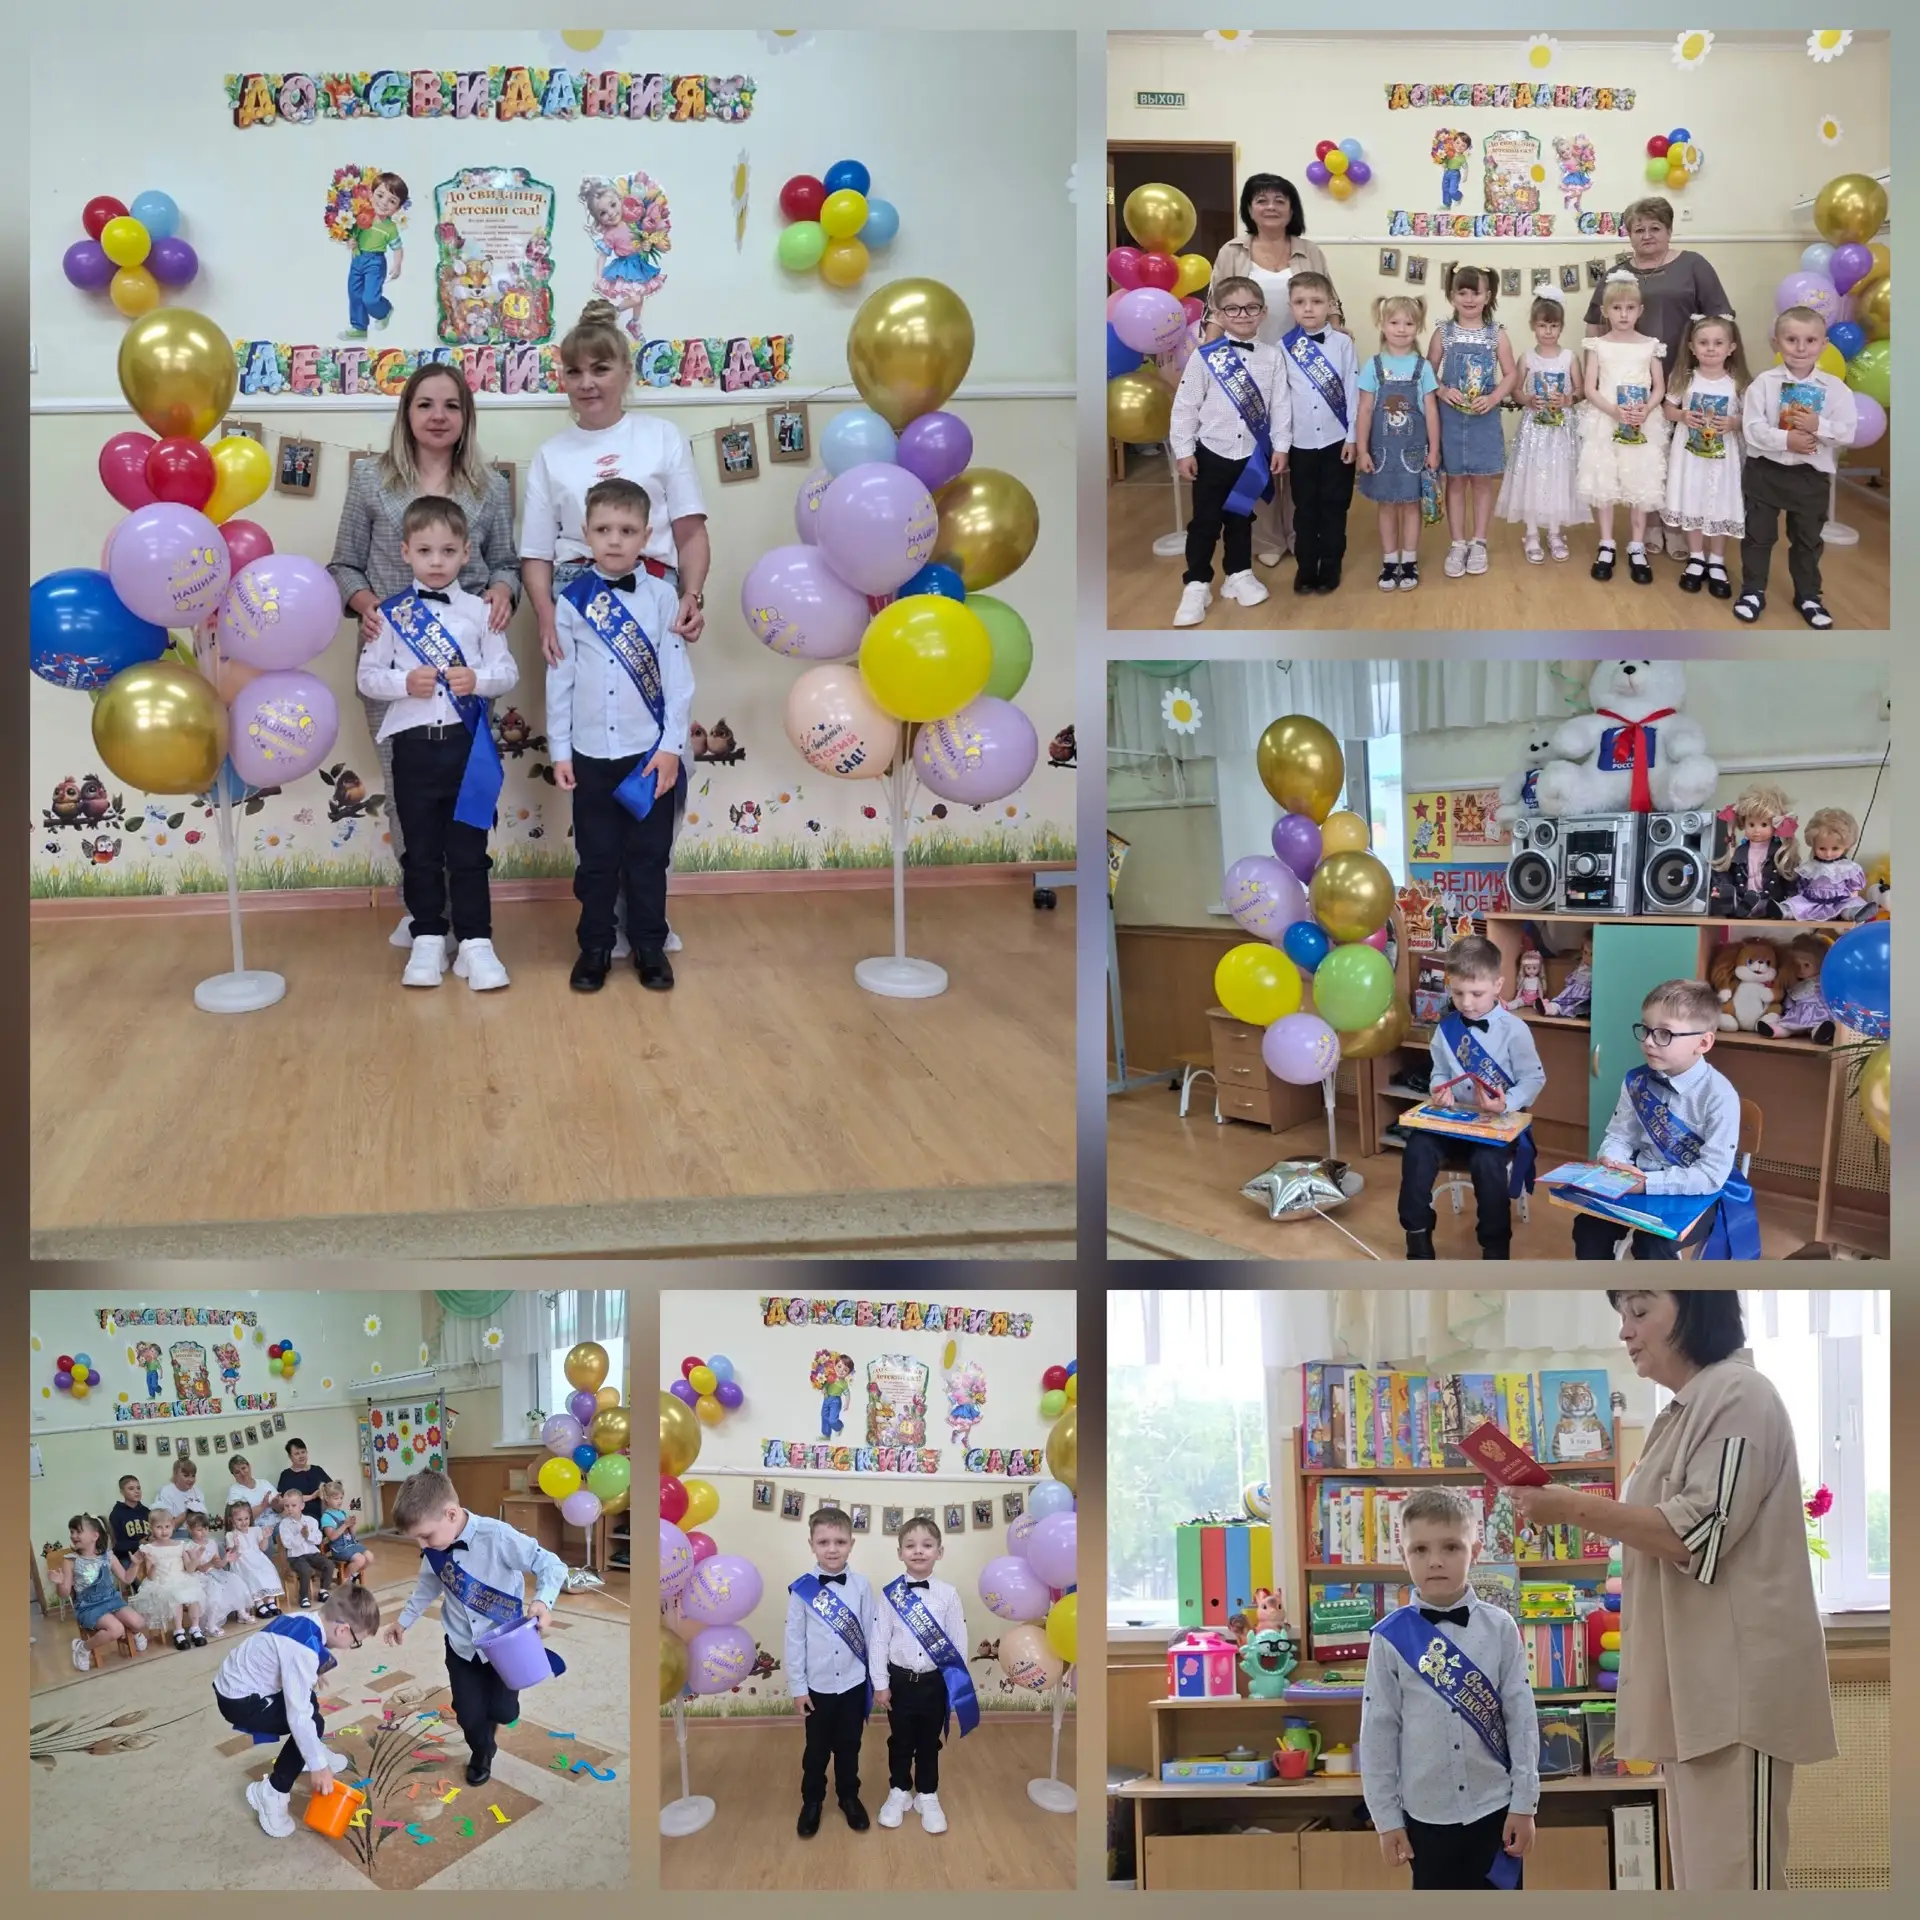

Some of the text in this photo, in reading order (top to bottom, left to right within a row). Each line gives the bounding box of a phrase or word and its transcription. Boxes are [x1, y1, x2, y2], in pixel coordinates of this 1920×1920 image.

[233, 65, 706, 130] ДО СВИДАНИЯ
[1140, 94, 1183, 105] ВЫХОД
[1388, 82, 1613, 111] ДО СВИДАНИЯ
[445, 190, 547, 205] До свидания,
[450, 204, 540, 217] детский сад!
[1389, 210, 1534, 237] ДЕТСКИЙ
[635, 334, 793, 393] САД!
[172, 574, 217, 602] НАШИМ
[254, 714, 296, 741] НАШИМ
[835, 748, 866, 774] САД!
[1436, 796, 1447, 810] 9
[1436, 811, 1447, 847] МАЯ
[764, 1297, 1011, 1337] ДО СВИДАНИЯ
[764, 1439, 1043, 1477] ДЕТСКИЙ САД!
[1585, 1544, 1599, 1554] 4-5
